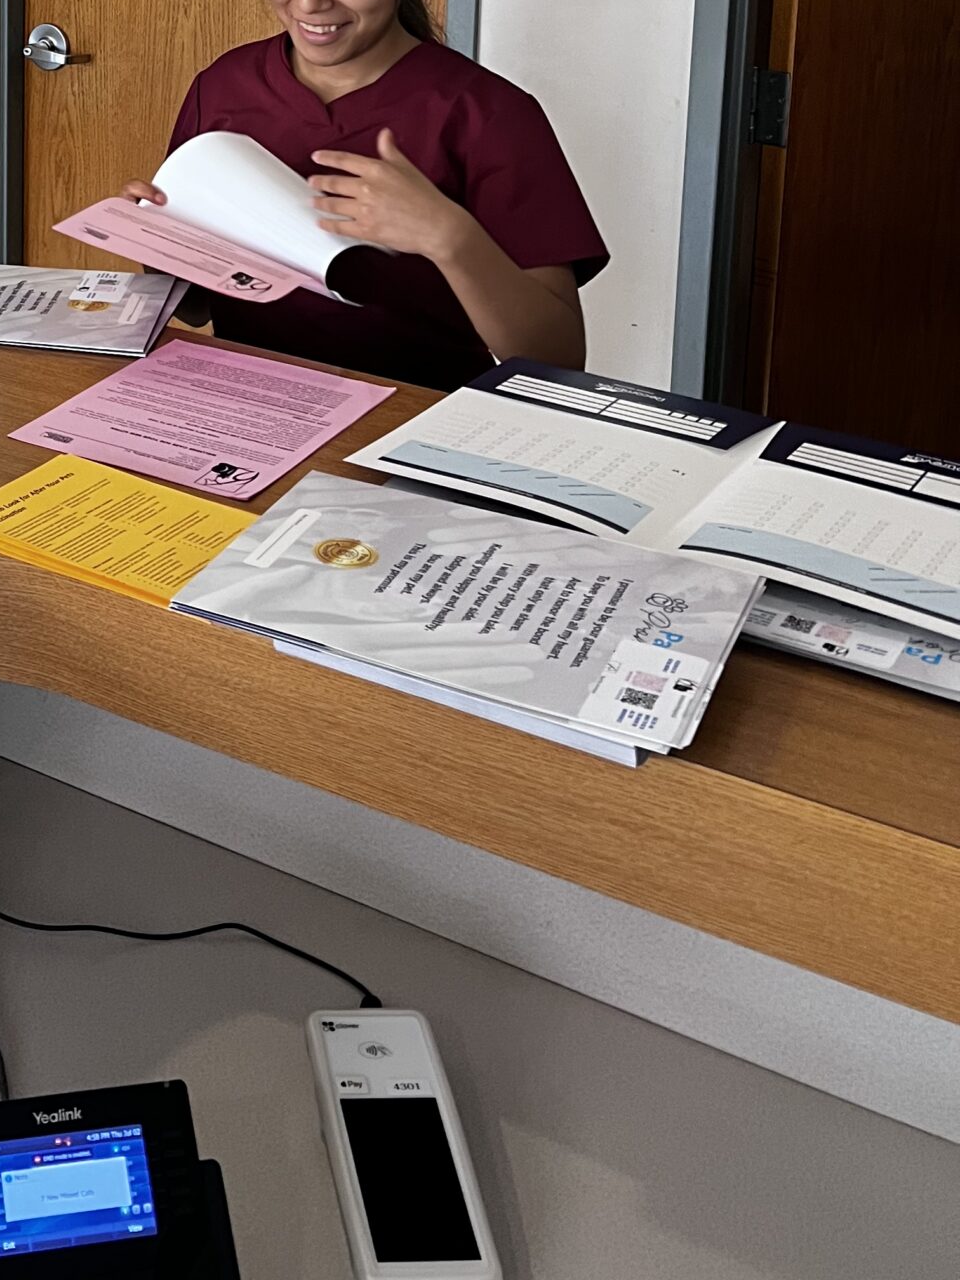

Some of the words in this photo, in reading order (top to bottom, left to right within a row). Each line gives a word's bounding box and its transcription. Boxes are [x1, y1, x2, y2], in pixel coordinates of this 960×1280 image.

[0, 498, 22, 508] Look
[15, 493, 33, 501] for
[26, 486, 48, 496] After
[42, 478, 63, 488] Your
[407, 542, 426, 556] This
[475, 542, 501, 566] Keeping
[392, 558, 410, 570] my
[402, 553, 416, 561] is
[426, 552, 443, 565] You
[443, 554, 466, 573] today
[417, 563, 433, 574] are
[464, 563, 483, 577] you
[494, 565, 511, 577] will
[520, 561, 540, 577] With
[372, 568, 401, 595] promise.
[407, 572, 425, 584] my
[435, 570, 454, 584] and
[488, 575, 503, 585] be
[507, 575, 528, 593] every
[537, 576, 556, 590] that
[563, 576, 581, 591] And
[595, 573, 610, 583] To
[397, 581, 418, 596] pet.
[451, 575, 476, 596] happy
[479, 583, 497, 594] by
[587, 581, 605, 596] love
[417, 582, 444, 606] always.
[443, 594, 462, 608] and
[469, 591, 490, 607] your
[497, 591, 518, 608] step
[526, 588, 547, 604] only
[559, 589, 573, 598] to
[576, 593, 595, 608] you
[604, 580, 631, 607] promise
[488, 605, 506, 620] you
[521, 602, 536, 613] we
[546, 596, 569, 617] honor
[570, 606, 590, 622] with
[601, 605, 616, 615] to
[423, 605, 453, 633] healthy,
[459, 606, 480, 623] side.
[539, 615, 556, 628] the
[596, 613, 612, 624] be
[478, 618, 499, 636] take,
[508, 612, 530, 633] share.
[564, 620, 581, 631] all
[584, 621, 606, 639] your
[528, 626, 549, 646] bond
[556, 628, 573, 641] my
[652, 630, 684, 649] Pa
[545, 639, 568, 662] heart.
[565, 636, 597, 670] guardian.
[903, 645, 944, 666] Pa
[347, 1080, 363, 1089] Pay
[393, 1082, 421, 1091] 4301
[32, 1107, 83, 1125] Yealink
[2, 1241, 16, 1250] Exit
